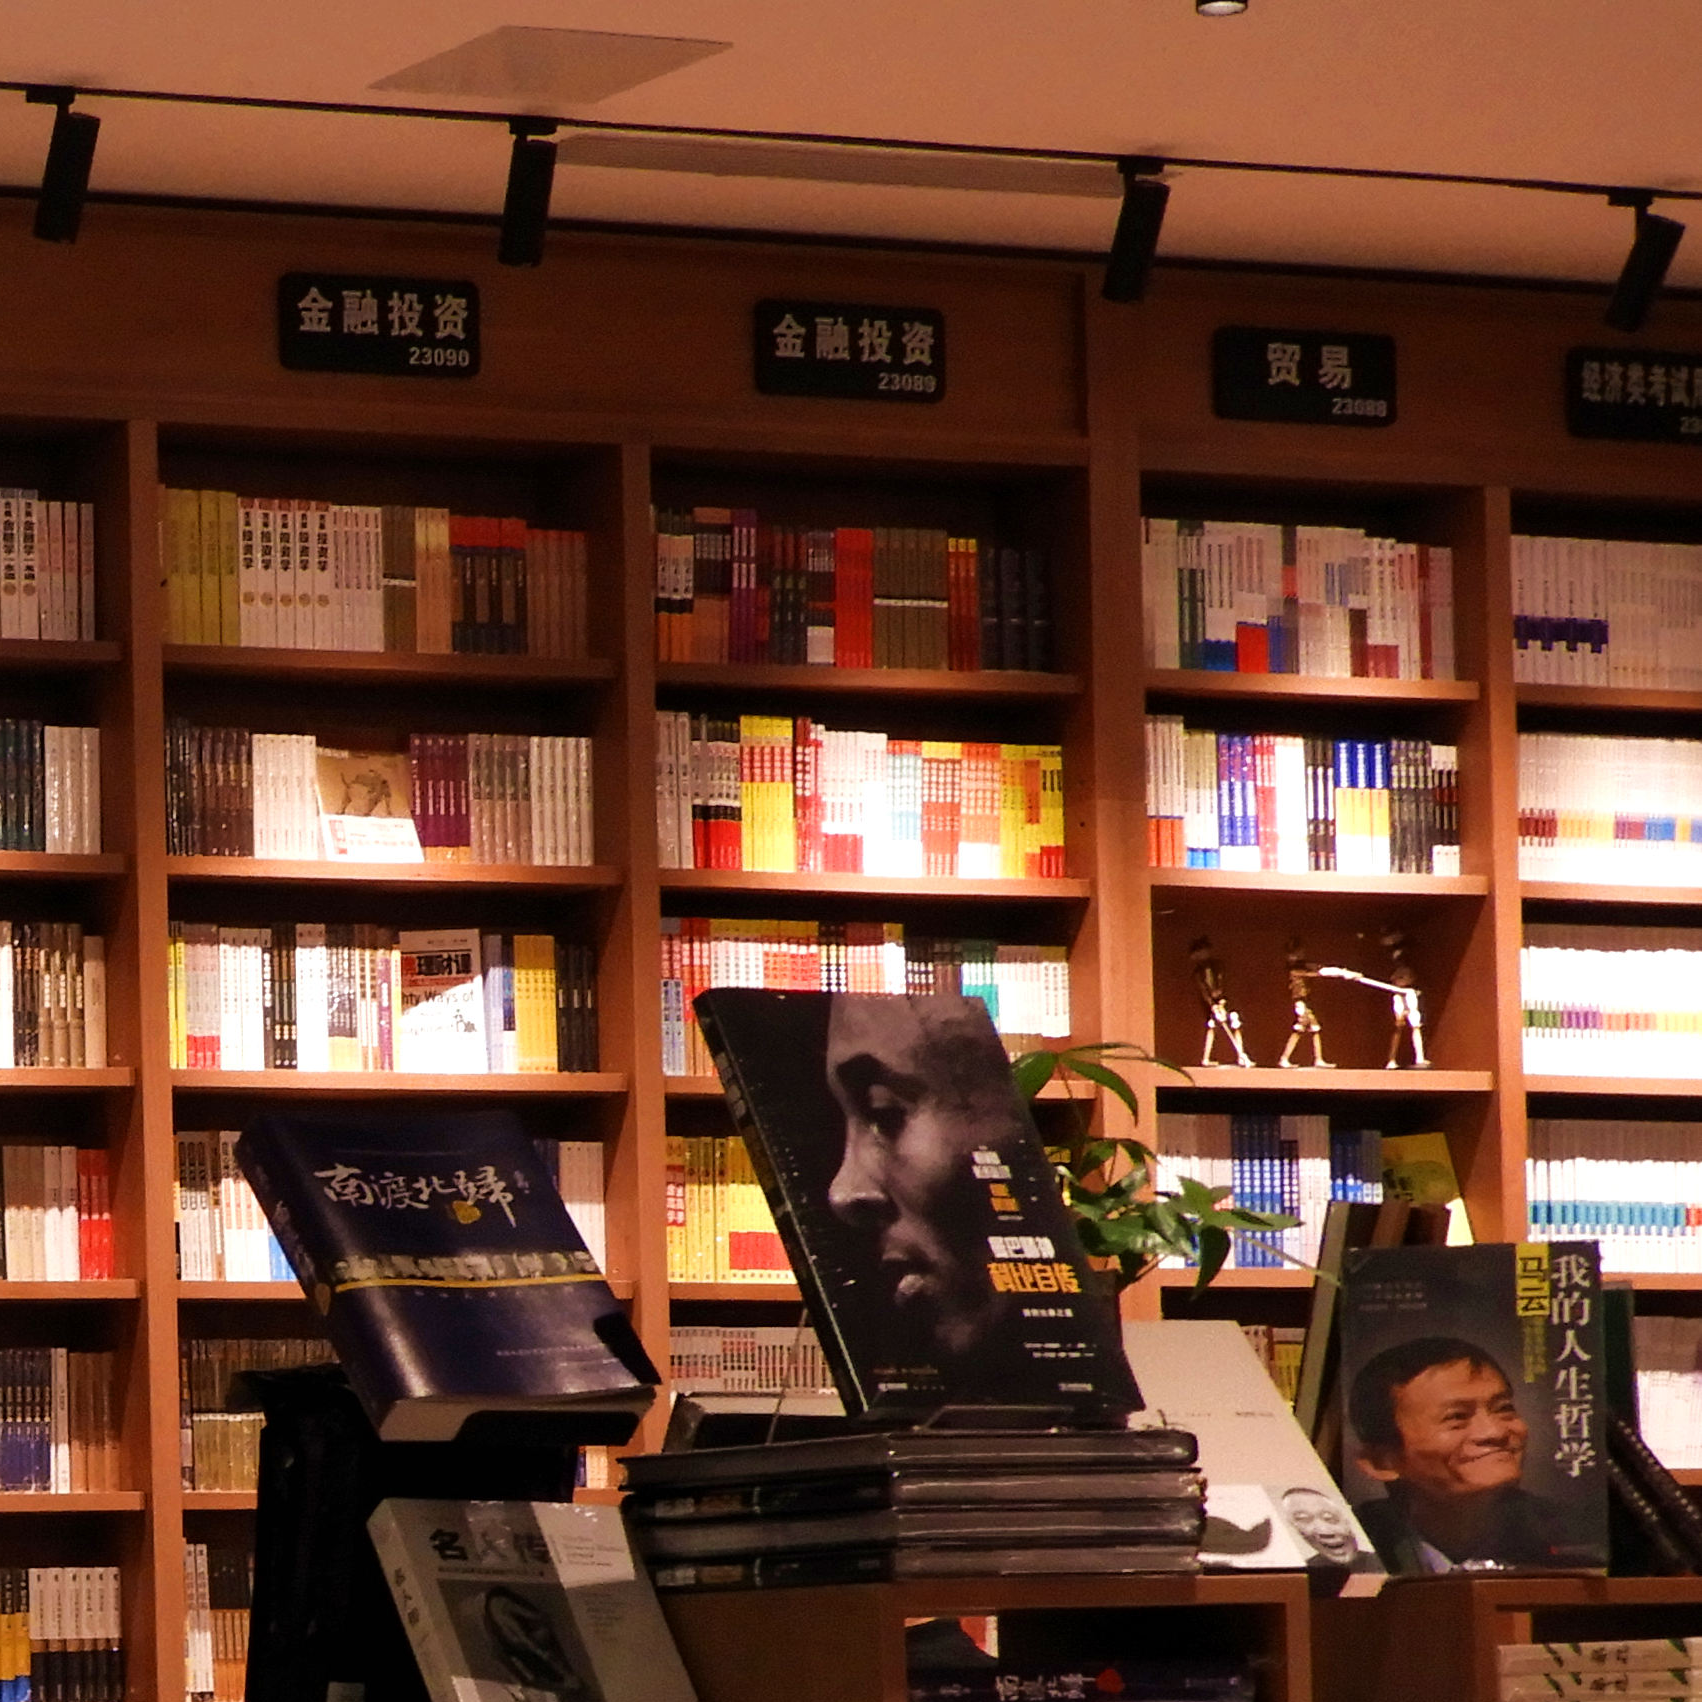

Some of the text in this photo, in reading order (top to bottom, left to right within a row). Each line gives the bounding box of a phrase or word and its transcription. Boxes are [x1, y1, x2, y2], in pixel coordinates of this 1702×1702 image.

[297, 286, 469, 341] 金融投资
[772, 313, 936, 369] 金融投资
[408, 346, 470, 369] 23090
[877, 369, 937, 395] 23089
[1267, 342, 1352, 390] 贸易
[1518, 1255, 1548, 1312] 马云
[1550, 1253, 1597, 1478] 我的人生哲学
